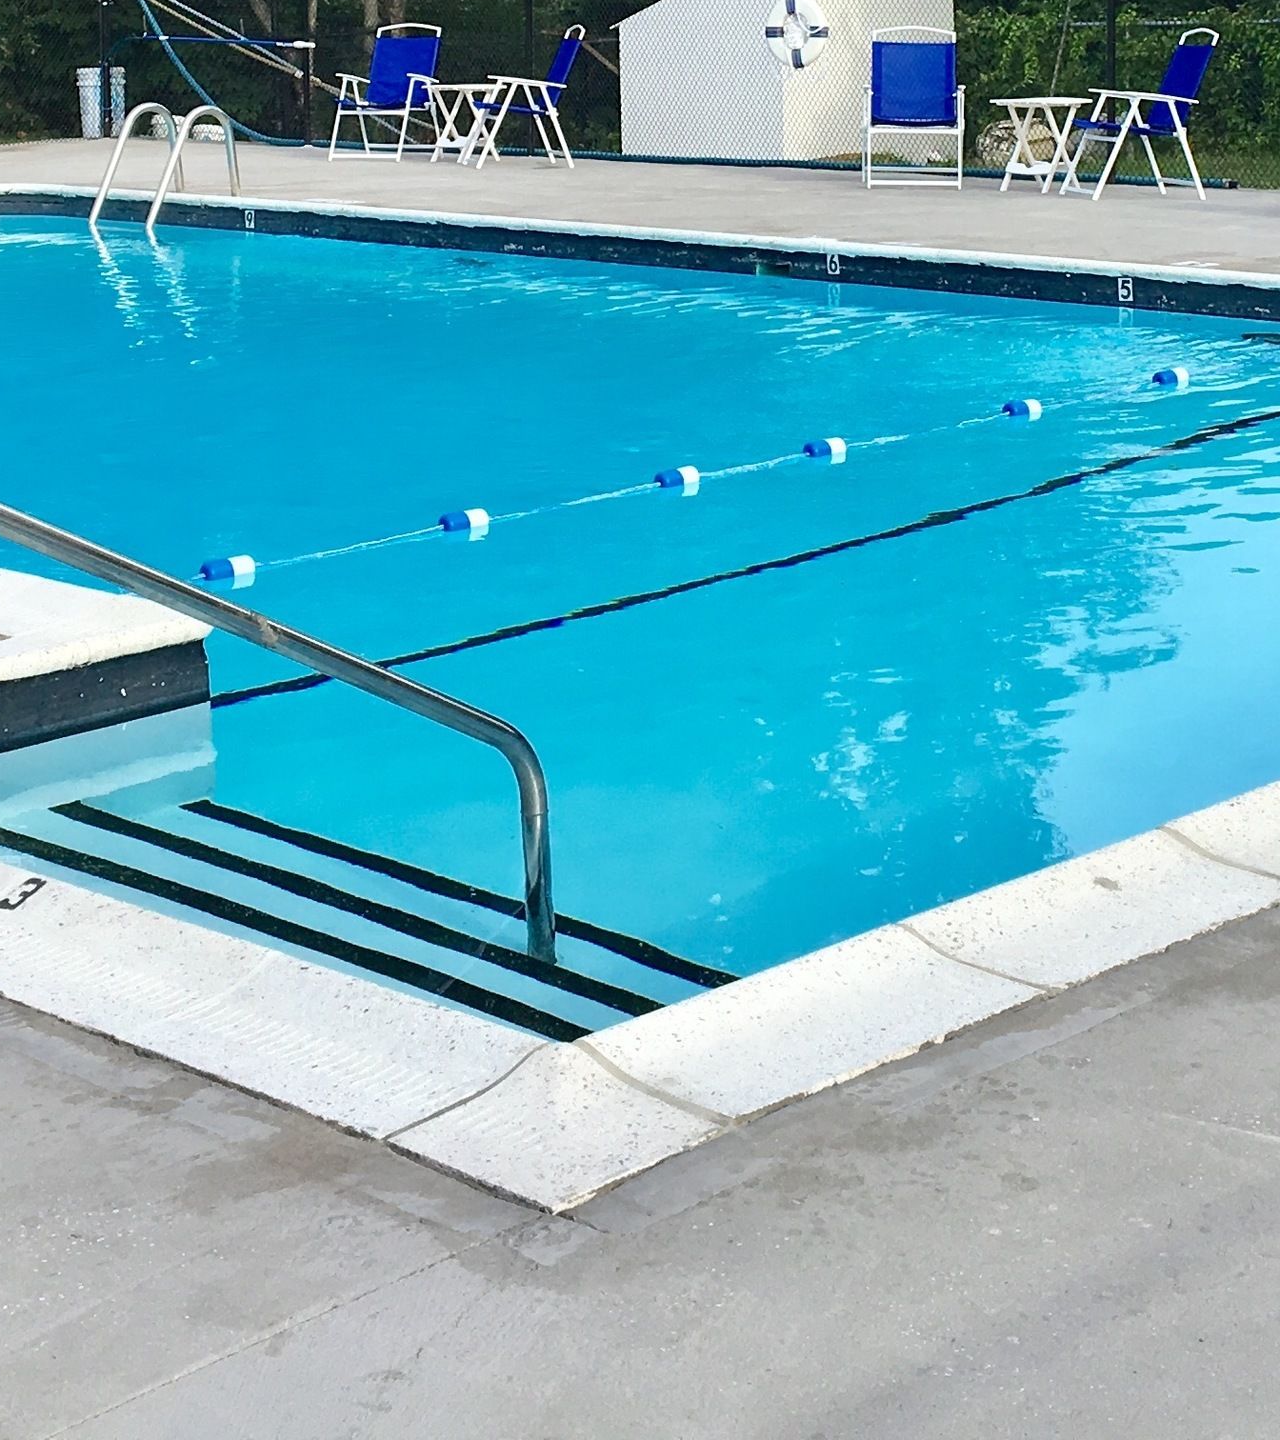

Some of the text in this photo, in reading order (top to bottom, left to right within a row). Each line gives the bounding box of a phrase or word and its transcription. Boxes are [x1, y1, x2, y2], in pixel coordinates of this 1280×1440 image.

[246, 211, 253, 227] 9
[829, 253, 838, 273] 6
[1120, 279, 1131, 300] 5
